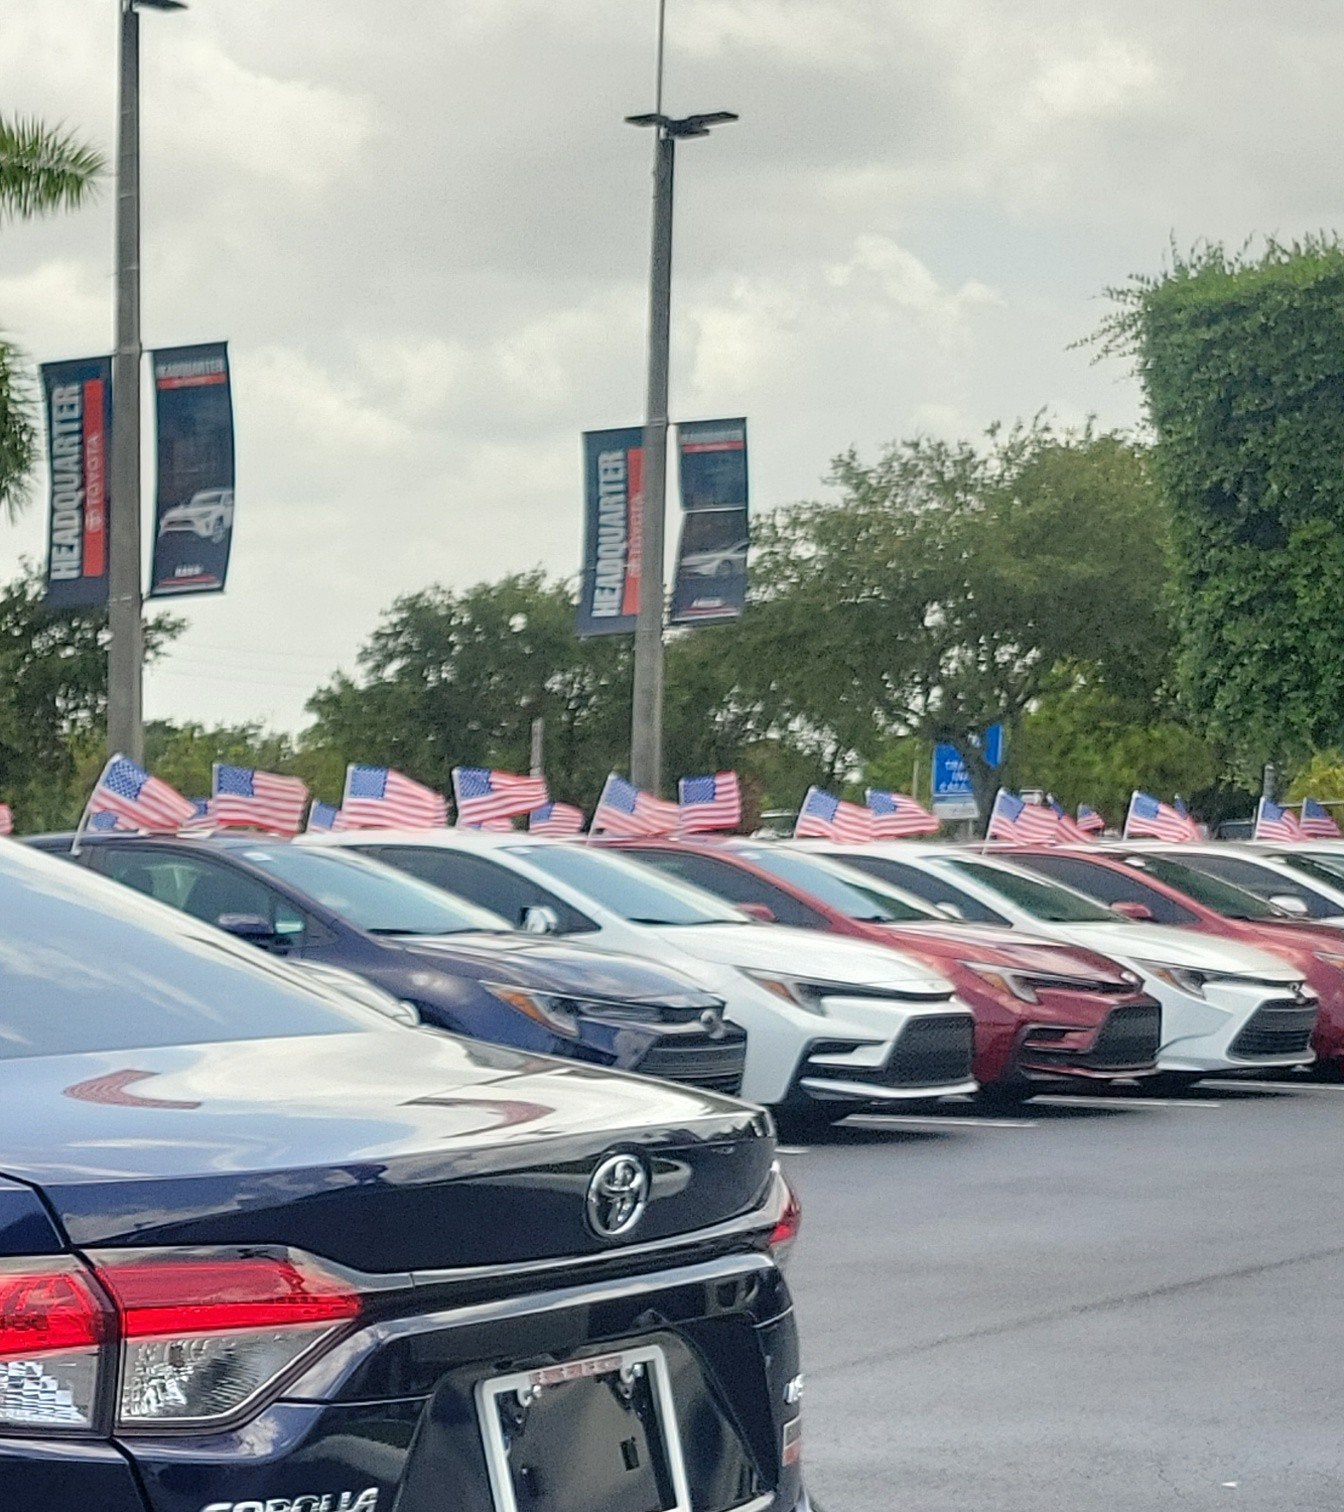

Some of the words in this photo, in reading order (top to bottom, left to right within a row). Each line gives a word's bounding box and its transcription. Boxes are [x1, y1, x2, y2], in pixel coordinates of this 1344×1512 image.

[50, 384, 85, 580] HEADQUARTER
[86, 432, 100, 508] TOYOTA
[591, 450, 628, 617] HEADQUARTER
